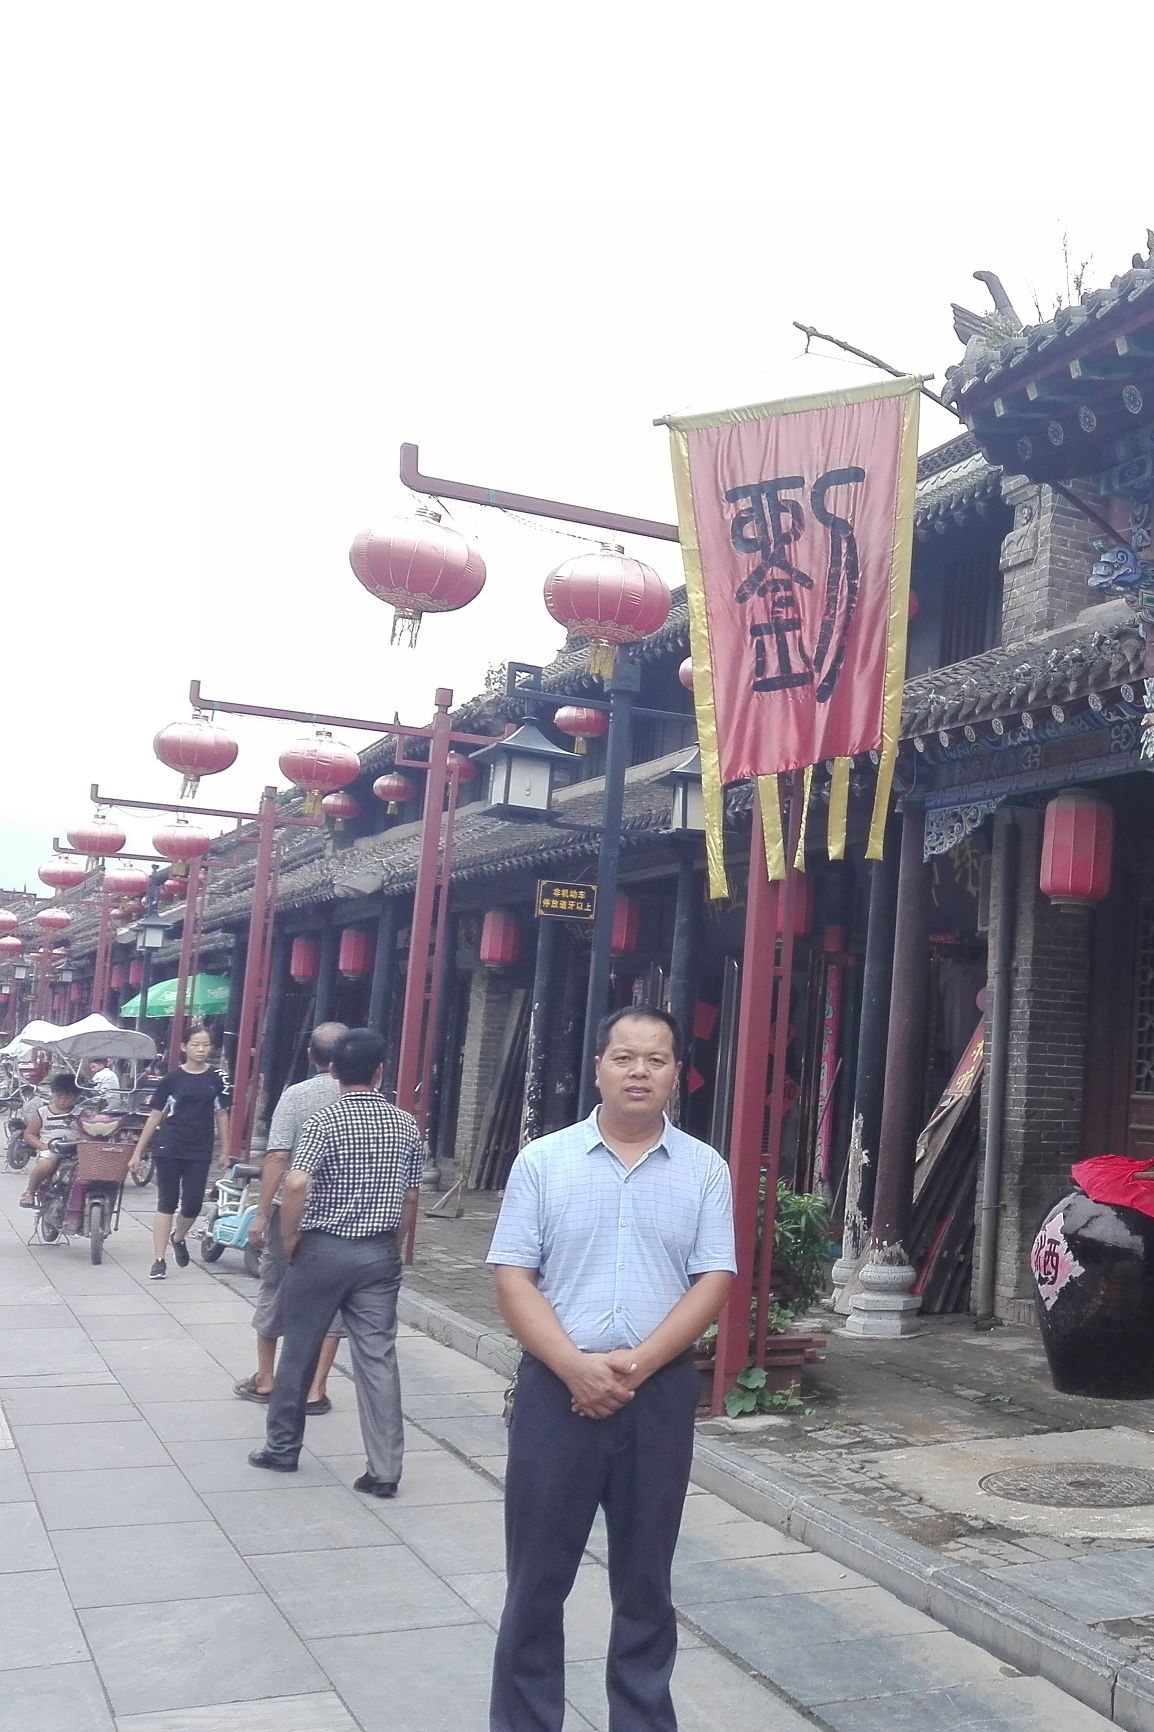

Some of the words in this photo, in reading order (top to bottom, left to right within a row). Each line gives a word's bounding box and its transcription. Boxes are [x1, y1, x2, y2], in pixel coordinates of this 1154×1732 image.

[552, 887, 586, 900] 非机动车
[542, 898, 592, 912] 停放道牙以上
[214, 1069, 230, 1095] RUN
